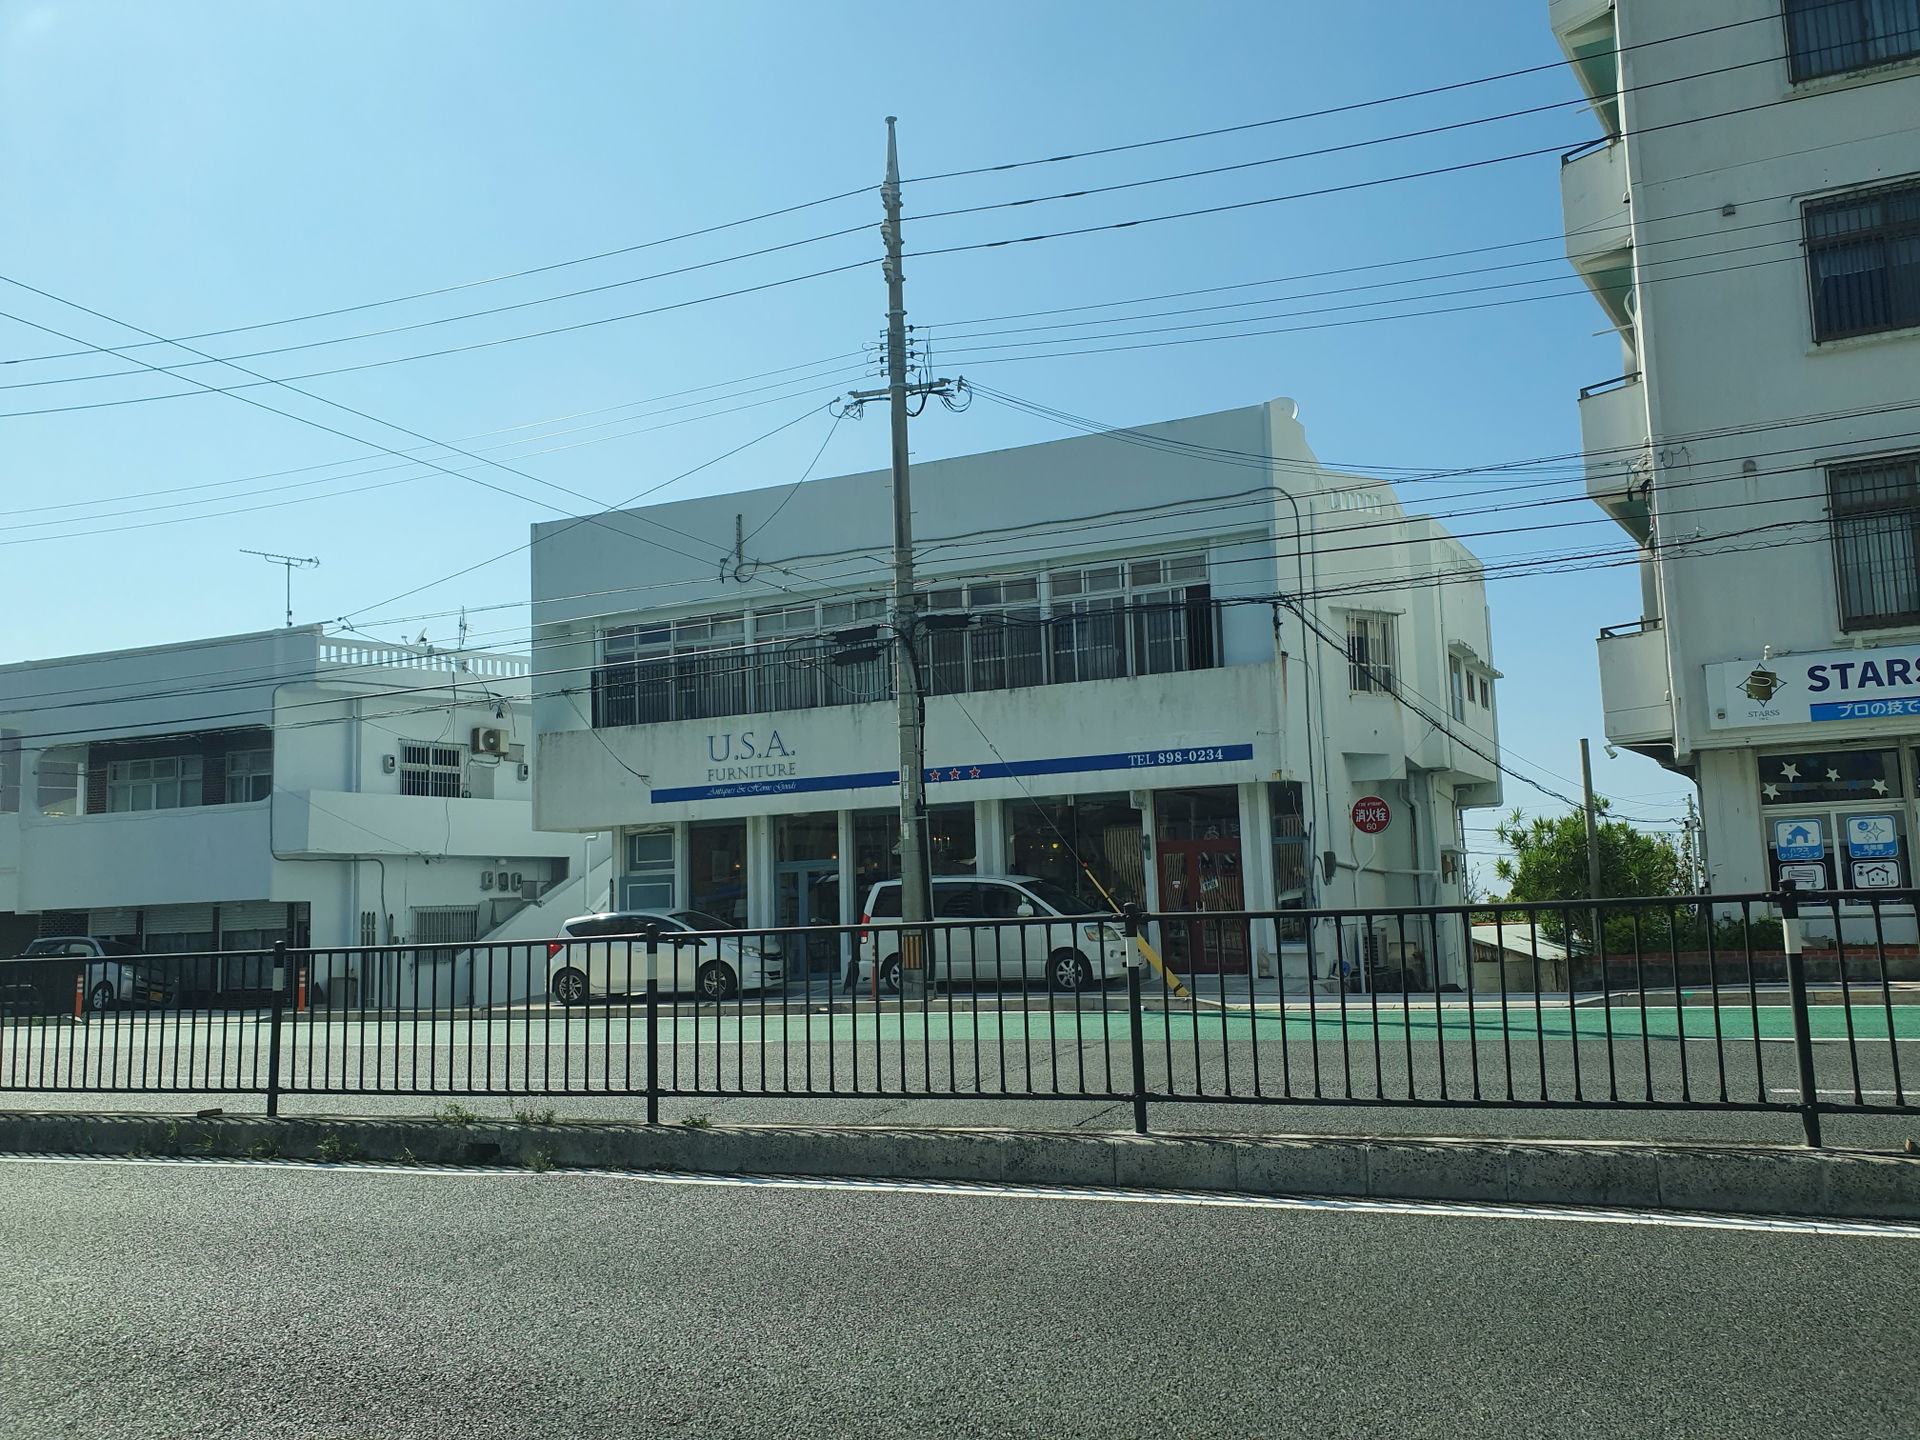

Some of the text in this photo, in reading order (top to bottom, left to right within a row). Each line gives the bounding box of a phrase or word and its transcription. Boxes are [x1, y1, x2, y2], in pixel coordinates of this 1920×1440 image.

[1807, 658, 1920, 692] STAR
[1747, 709, 1780, 718] STARSS
[706, 729, 796, 762] U.S.A.
[1128, 748, 1223, 766] TEL 898-0234
[707, 763, 796, 782] FURNITURE
[1356, 808, 1387, 822] 消火栓
[1366, 822, 1377, 831] 60
